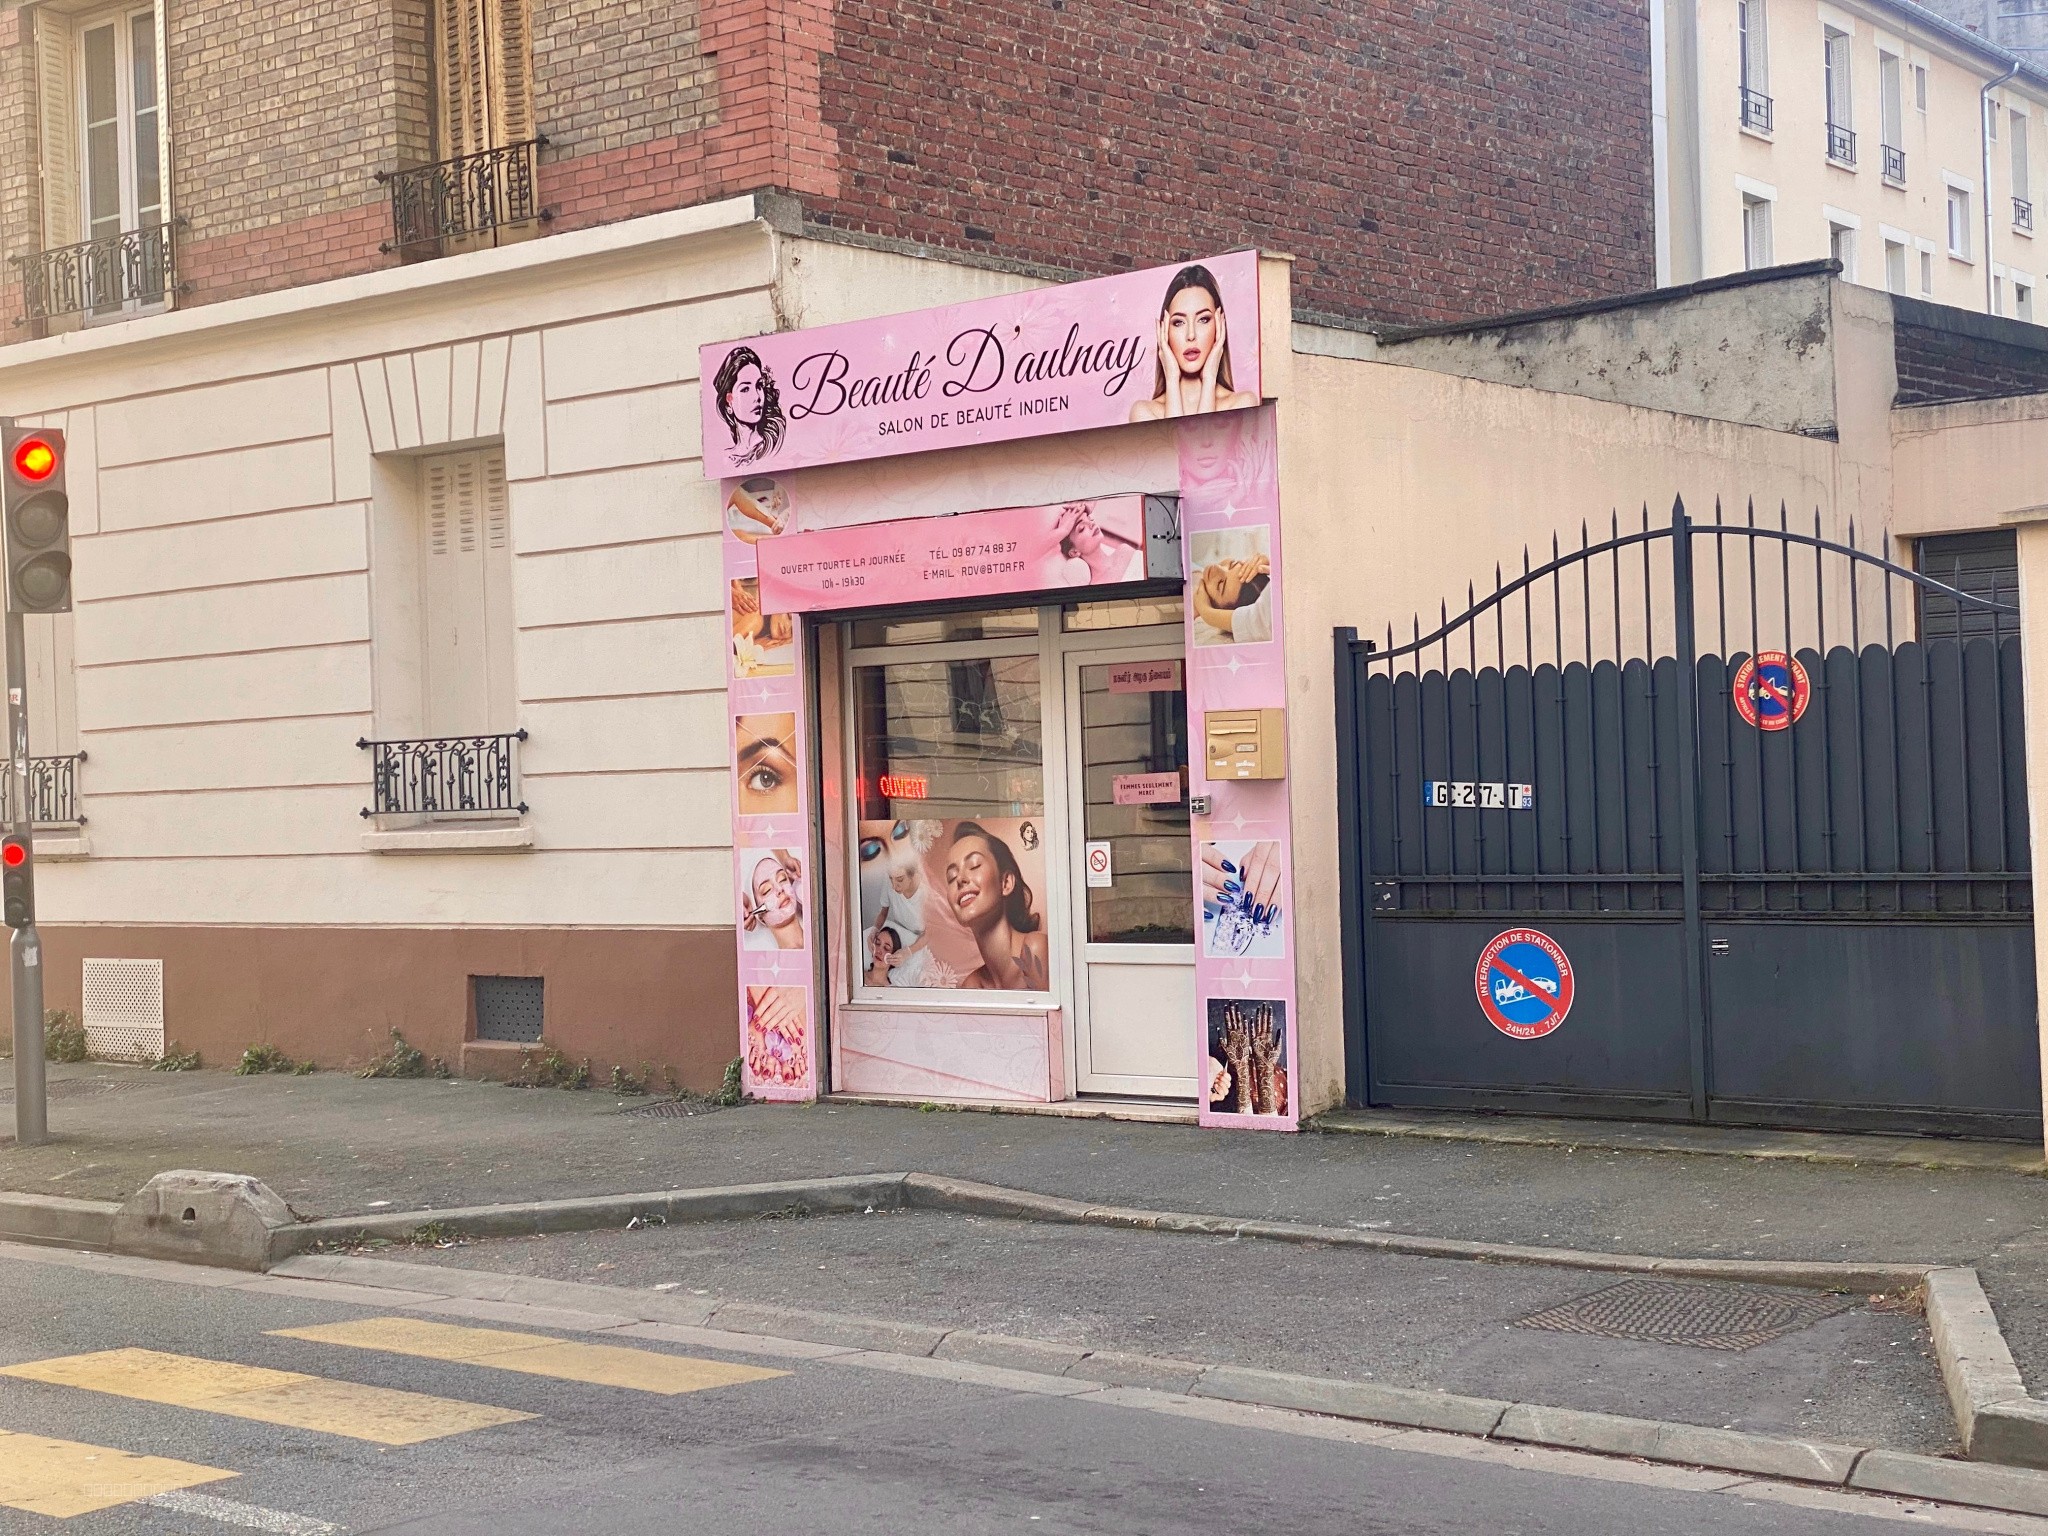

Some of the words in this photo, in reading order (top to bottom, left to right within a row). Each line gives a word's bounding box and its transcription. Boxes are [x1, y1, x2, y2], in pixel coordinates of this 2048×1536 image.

[789, 349, 936, 420] Beauté
[942, 322, 1146, 397] D'aulnay
[878, 416, 923, 436] SALON
[930, 412, 949, 429] DE
[956, 397, 1012, 425] BEAUTÉ
[1019, 394, 1069, 416] INDIEN
[952, 548, 963, 558] 09
[965, 546, 976, 556] 87
[978, 545, 990, 555] 74
[992, 543, 1004, 553] 88
[1006, 542, 1017, 552] 37
[781, 563, 814, 575] OUVERT
[816, 559, 850, 571] TOURTE
[853, 557, 866, 568] LA
[868, 550, 906, 566] JOURNÉE
[822, 578, 834, 589] 10h
[841, 576, 865, 588] 19h30
[923, 569, 955, 580] E-MAIL
[879, 776, 928, 799] OUVERT
[1522, 797, 1532, 807] 93
[1480, 936, 1509, 997] INTERDICTION
[1510, 933, 1523, 943] DE
[1524, 933, 1568, 977] STATIONNER
[1505, 1023, 1536, 1036] 24H/24
[1544, 1012, 1561, 1029] 7J/7
